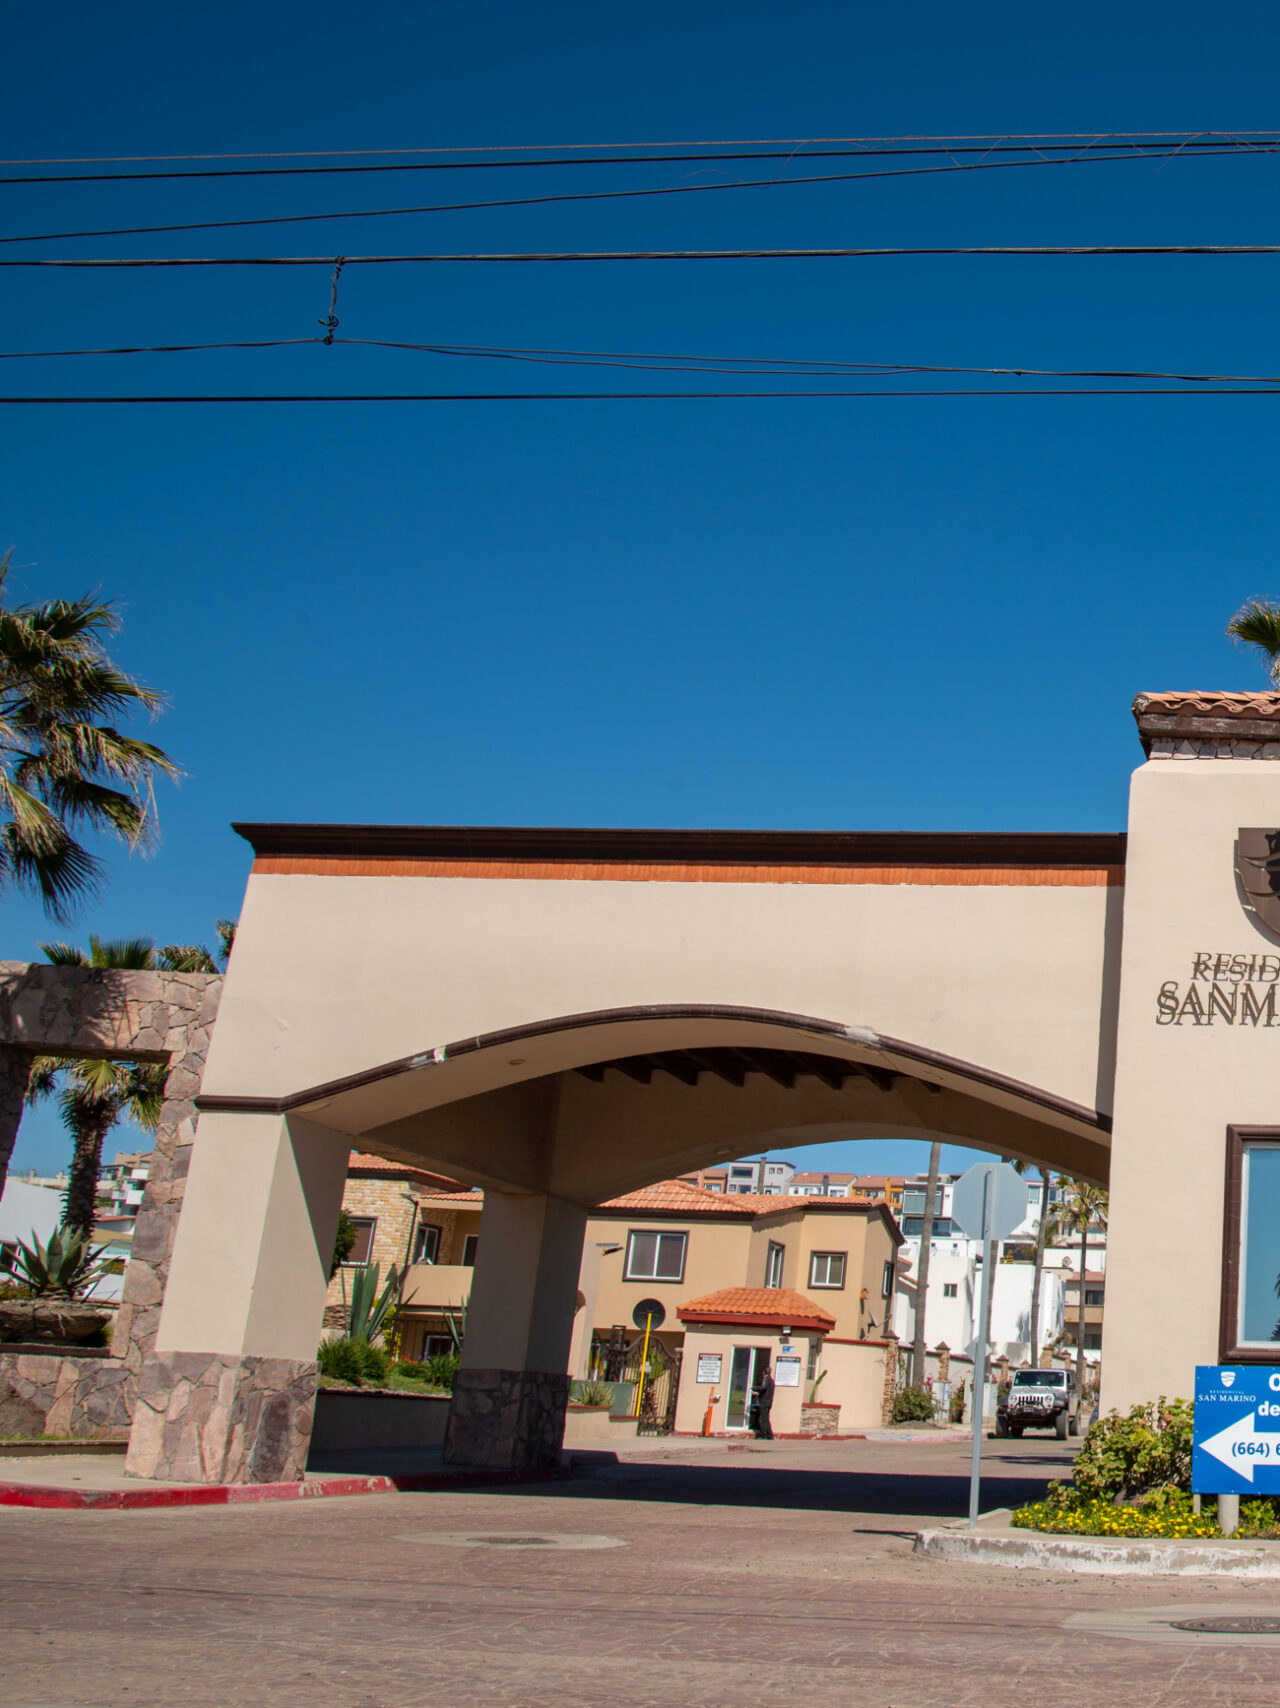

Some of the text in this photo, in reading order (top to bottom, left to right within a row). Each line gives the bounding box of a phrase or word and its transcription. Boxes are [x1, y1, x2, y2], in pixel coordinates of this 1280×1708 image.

[1198, 1394, 1257, 1403] SAN MARINO
[1257, 1400, 1280, 1417] de
[1231, 1441, 1270, 1458] (664)
